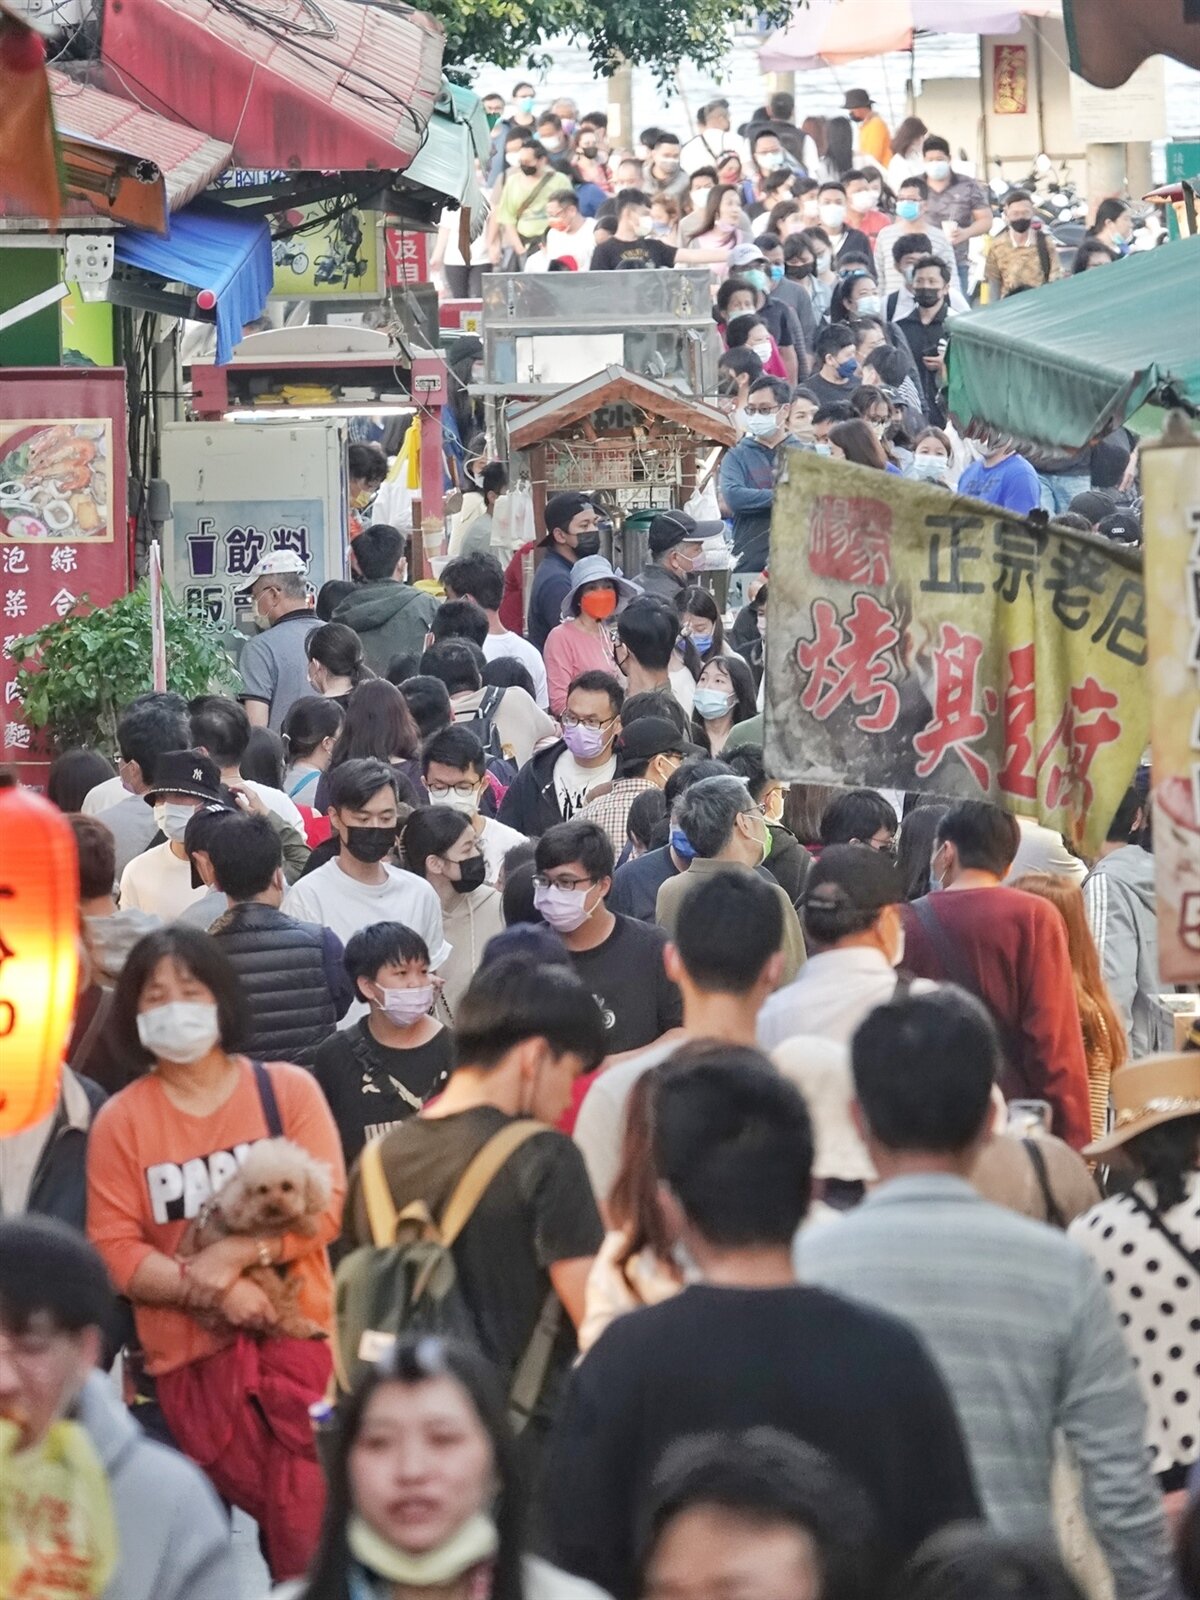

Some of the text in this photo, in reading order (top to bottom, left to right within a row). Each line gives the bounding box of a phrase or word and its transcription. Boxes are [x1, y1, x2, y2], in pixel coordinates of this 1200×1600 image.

[226, 527, 311, 574] 飲料
[919, 513, 1148, 667] 正宗老店
